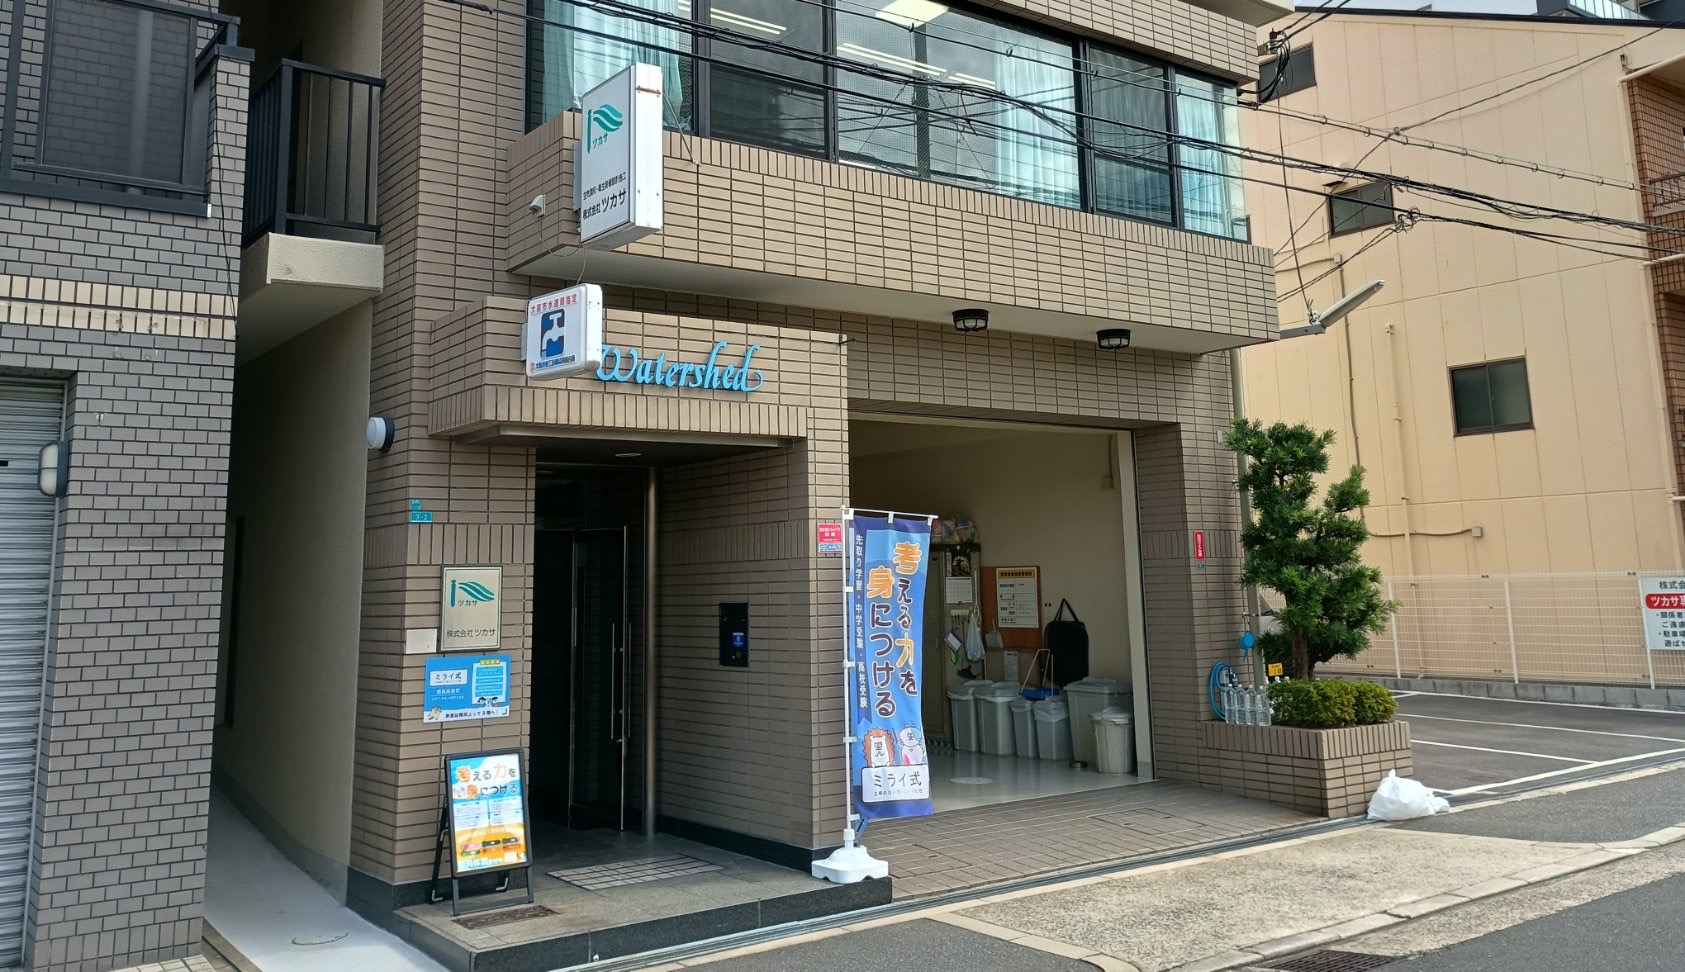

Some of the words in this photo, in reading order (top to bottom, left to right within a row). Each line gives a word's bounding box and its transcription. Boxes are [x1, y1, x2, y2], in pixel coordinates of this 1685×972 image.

[592, 132, 608, 149] ツカサ
[582, 188, 627, 220] 株式会社ツカサ
[597, 340, 765, 393] Watershed
[892, 541, 921, 697] 考える力を
[446, 628, 496, 638] 株式会社ツカサ
[866, 565, 897, 717] 身につける
[435, 671, 462, 680] ミライ式
[457, 763, 517, 783] 考える力を
[873, 770, 922, 788] ミライ式
[466, 784, 519, 799] 身につける
